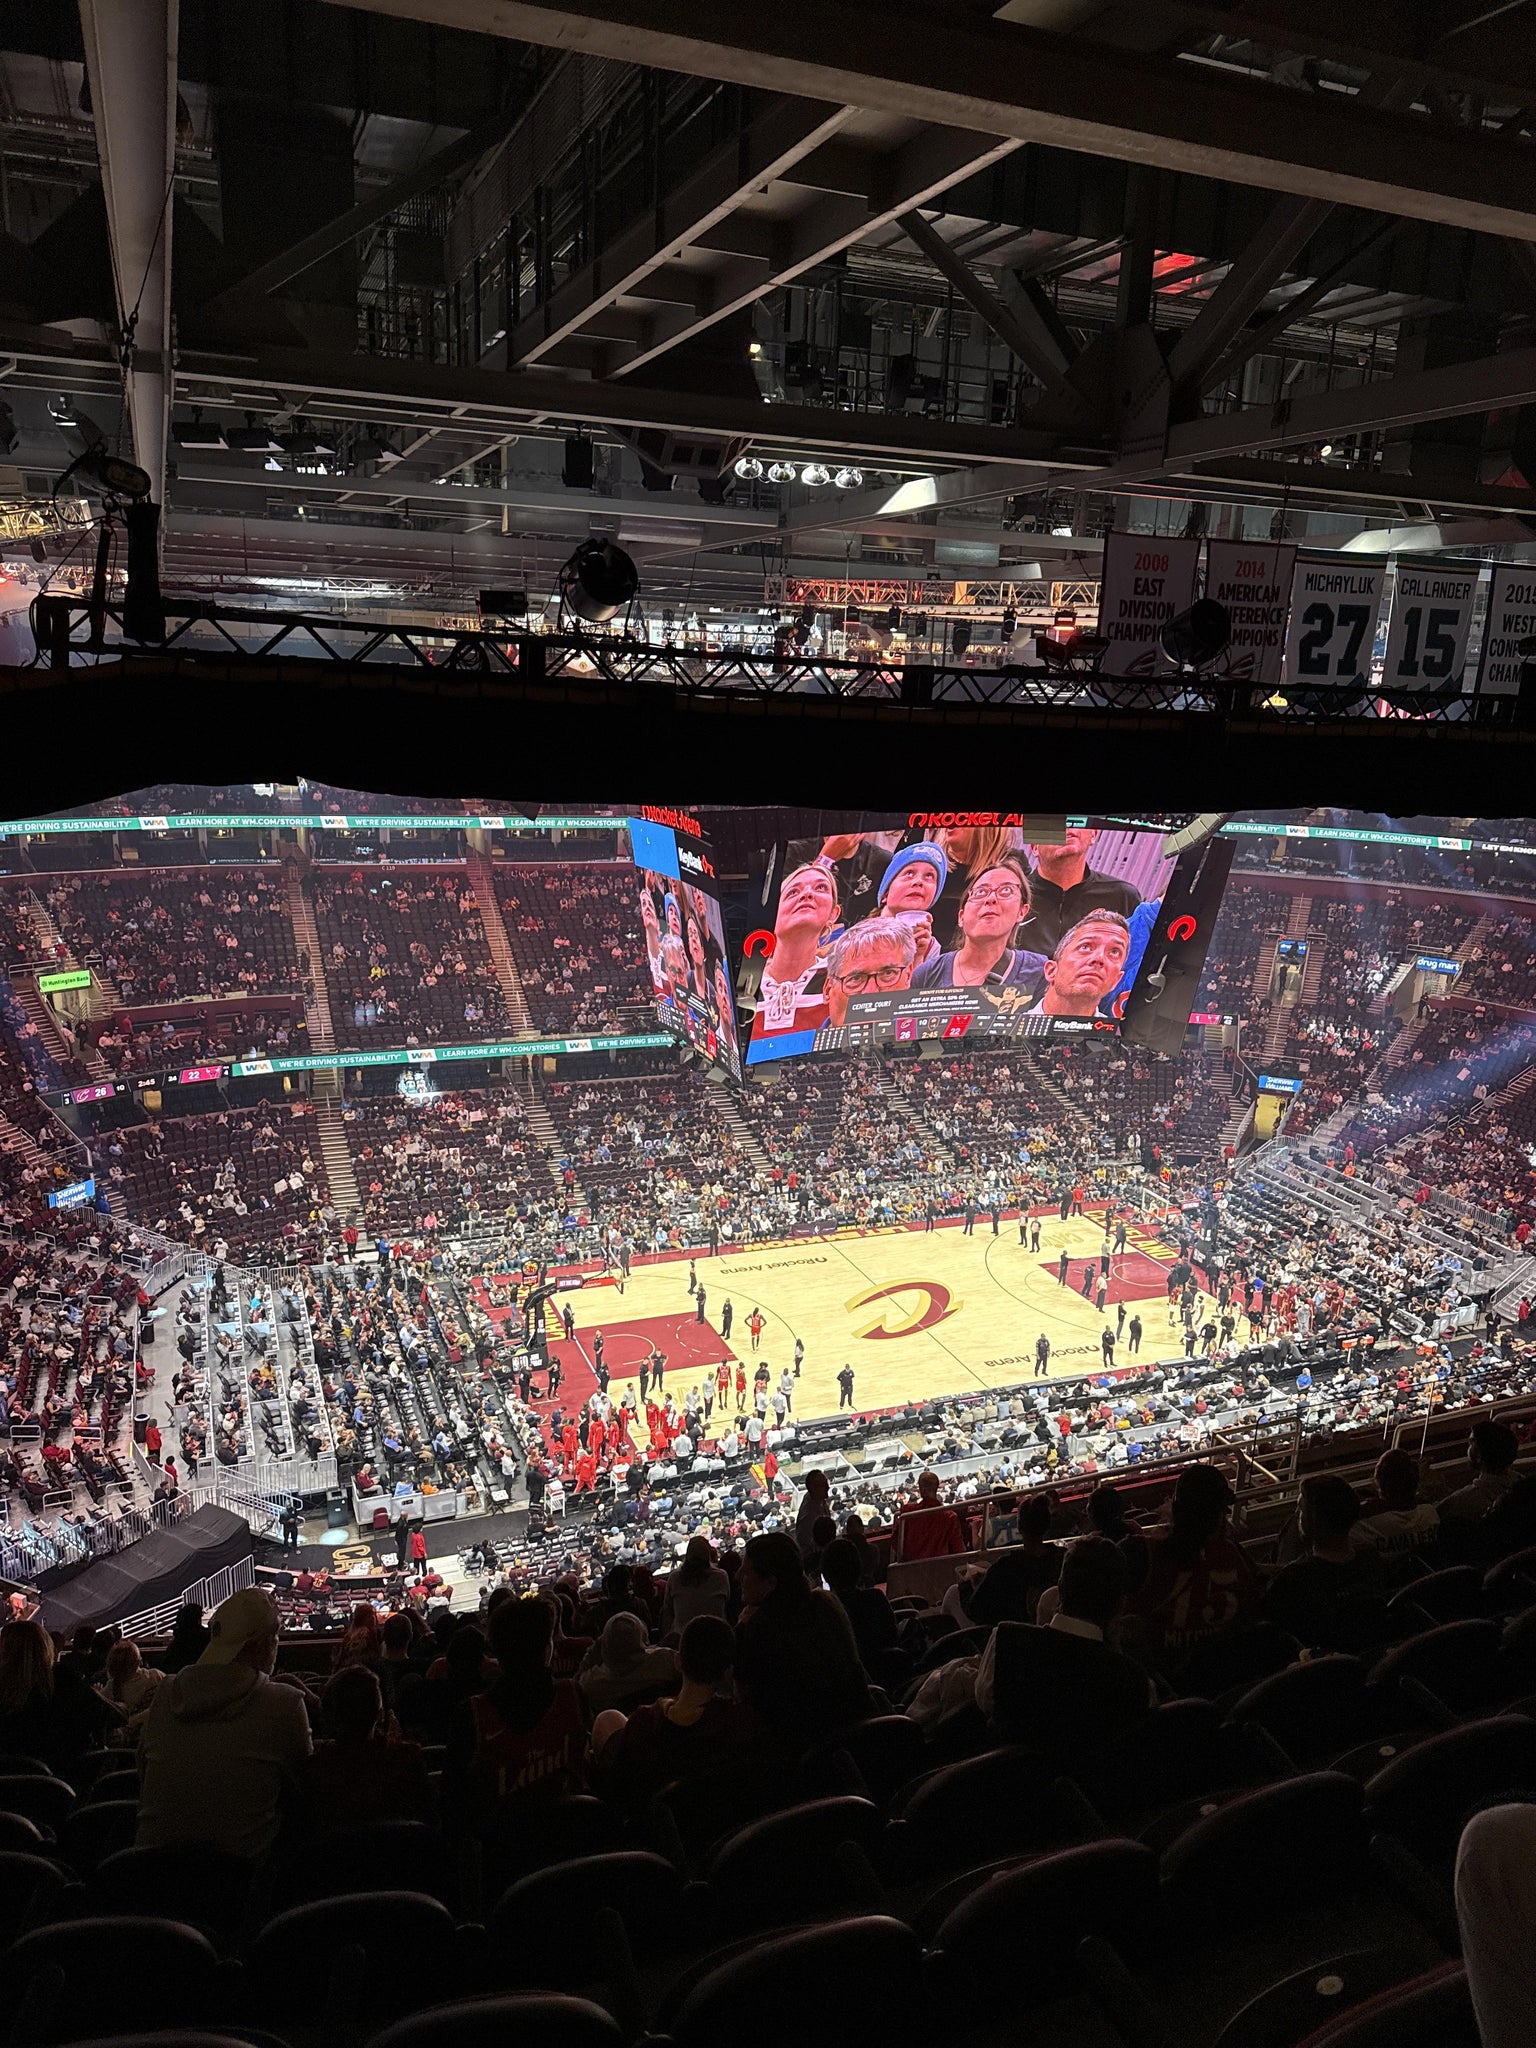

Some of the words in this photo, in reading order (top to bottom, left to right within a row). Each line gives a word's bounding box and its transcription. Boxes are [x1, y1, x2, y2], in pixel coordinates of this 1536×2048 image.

[1134, 552, 1169, 572] 2008
[1235, 559, 1265, 578] 2014
[1133, 577, 1166, 597] EAST
[1304, 572, 1376, 595] MICHAYLUK
[1400, 578, 1472, 600] CALLANDER
[1217, 582, 1281, 603] AMERICAN
[1118, 599, 1176, 620] DIVISION
[1226, 606, 1285, 625] NFERENCE
[1502, 613, 1536, 634] WEST
[1229, 628, 1279, 647] MPIONS
[1297, 602, 1372, 676] 27
[1397, 606, 1461, 678] 15
[25, 822, 60, 831] DRIVING
[62, 820, 131, 830] SUSTAINABILITY
[175, 818, 201, 826] LEARN
[204, 818, 228, 826] MORE
[230, 818, 239, 826] AT
[241, 818, 314, 826] WM.COM/STORIES
[324, 818, 345, 826] WM
[355, 818, 380, 826] WE'RE
[381, 818, 411, 826] DRIVING
[413, 818, 472, 826] SUSTAINABILITY
[510, 819, 534, 827] LEARN
[535, 819, 556, 827] MORE
[557, 819, 566, 827] AT
[1315, 829, 1338, 837] LEARN
[1370, 833, 1432, 845] WM.COM/STORIES
[1441, 839, 1459, 847] WM
[1417, 957, 1438, 970] drug
[1438, 962, 1460, 971] mart
[48, 977, 76, 986] Huntington
[1054, 1020, 1093, 1030] KeyBank
[900, 1031, 911, 1039] 26
[921, 1031, 938, 1039] 2:45
[949, 1028, 961, 1036] 22
[597, 1039, 618, 1047] WE'RE
[619, 1038, 646, 1046] DRIVING
[411, 1052, 432, 1060] WM
[442, 1048, 466, 1057] LEARN
[467, 1047, 488, 1056] MORE
[489, 1047, 498, 1055] AT
[499, 1043, 560, 1054] WM.COM/STORIES
[245, 1063, 269, 1072] WM
[279, 1059, 304, 1068] WE'RE
[306, 1057, 338, 1067] DRIVING
[340, 1054, 399, 1064] SUSTAINABILITY
[95, 1087, 107, 1097] 26
[137, 1079, 156, 1088] 2:45
[188, 1071, 200, 1080] 22
[1267, 1076, 1295, 1086] SHERWIN
[57, 1183, 86, 1200] SHERWIN
[719, 1264, 762, 1275] Arena
[765, 1257, 814, 1270] Rocket
[983, 1355, 1031, 1368] Arena
